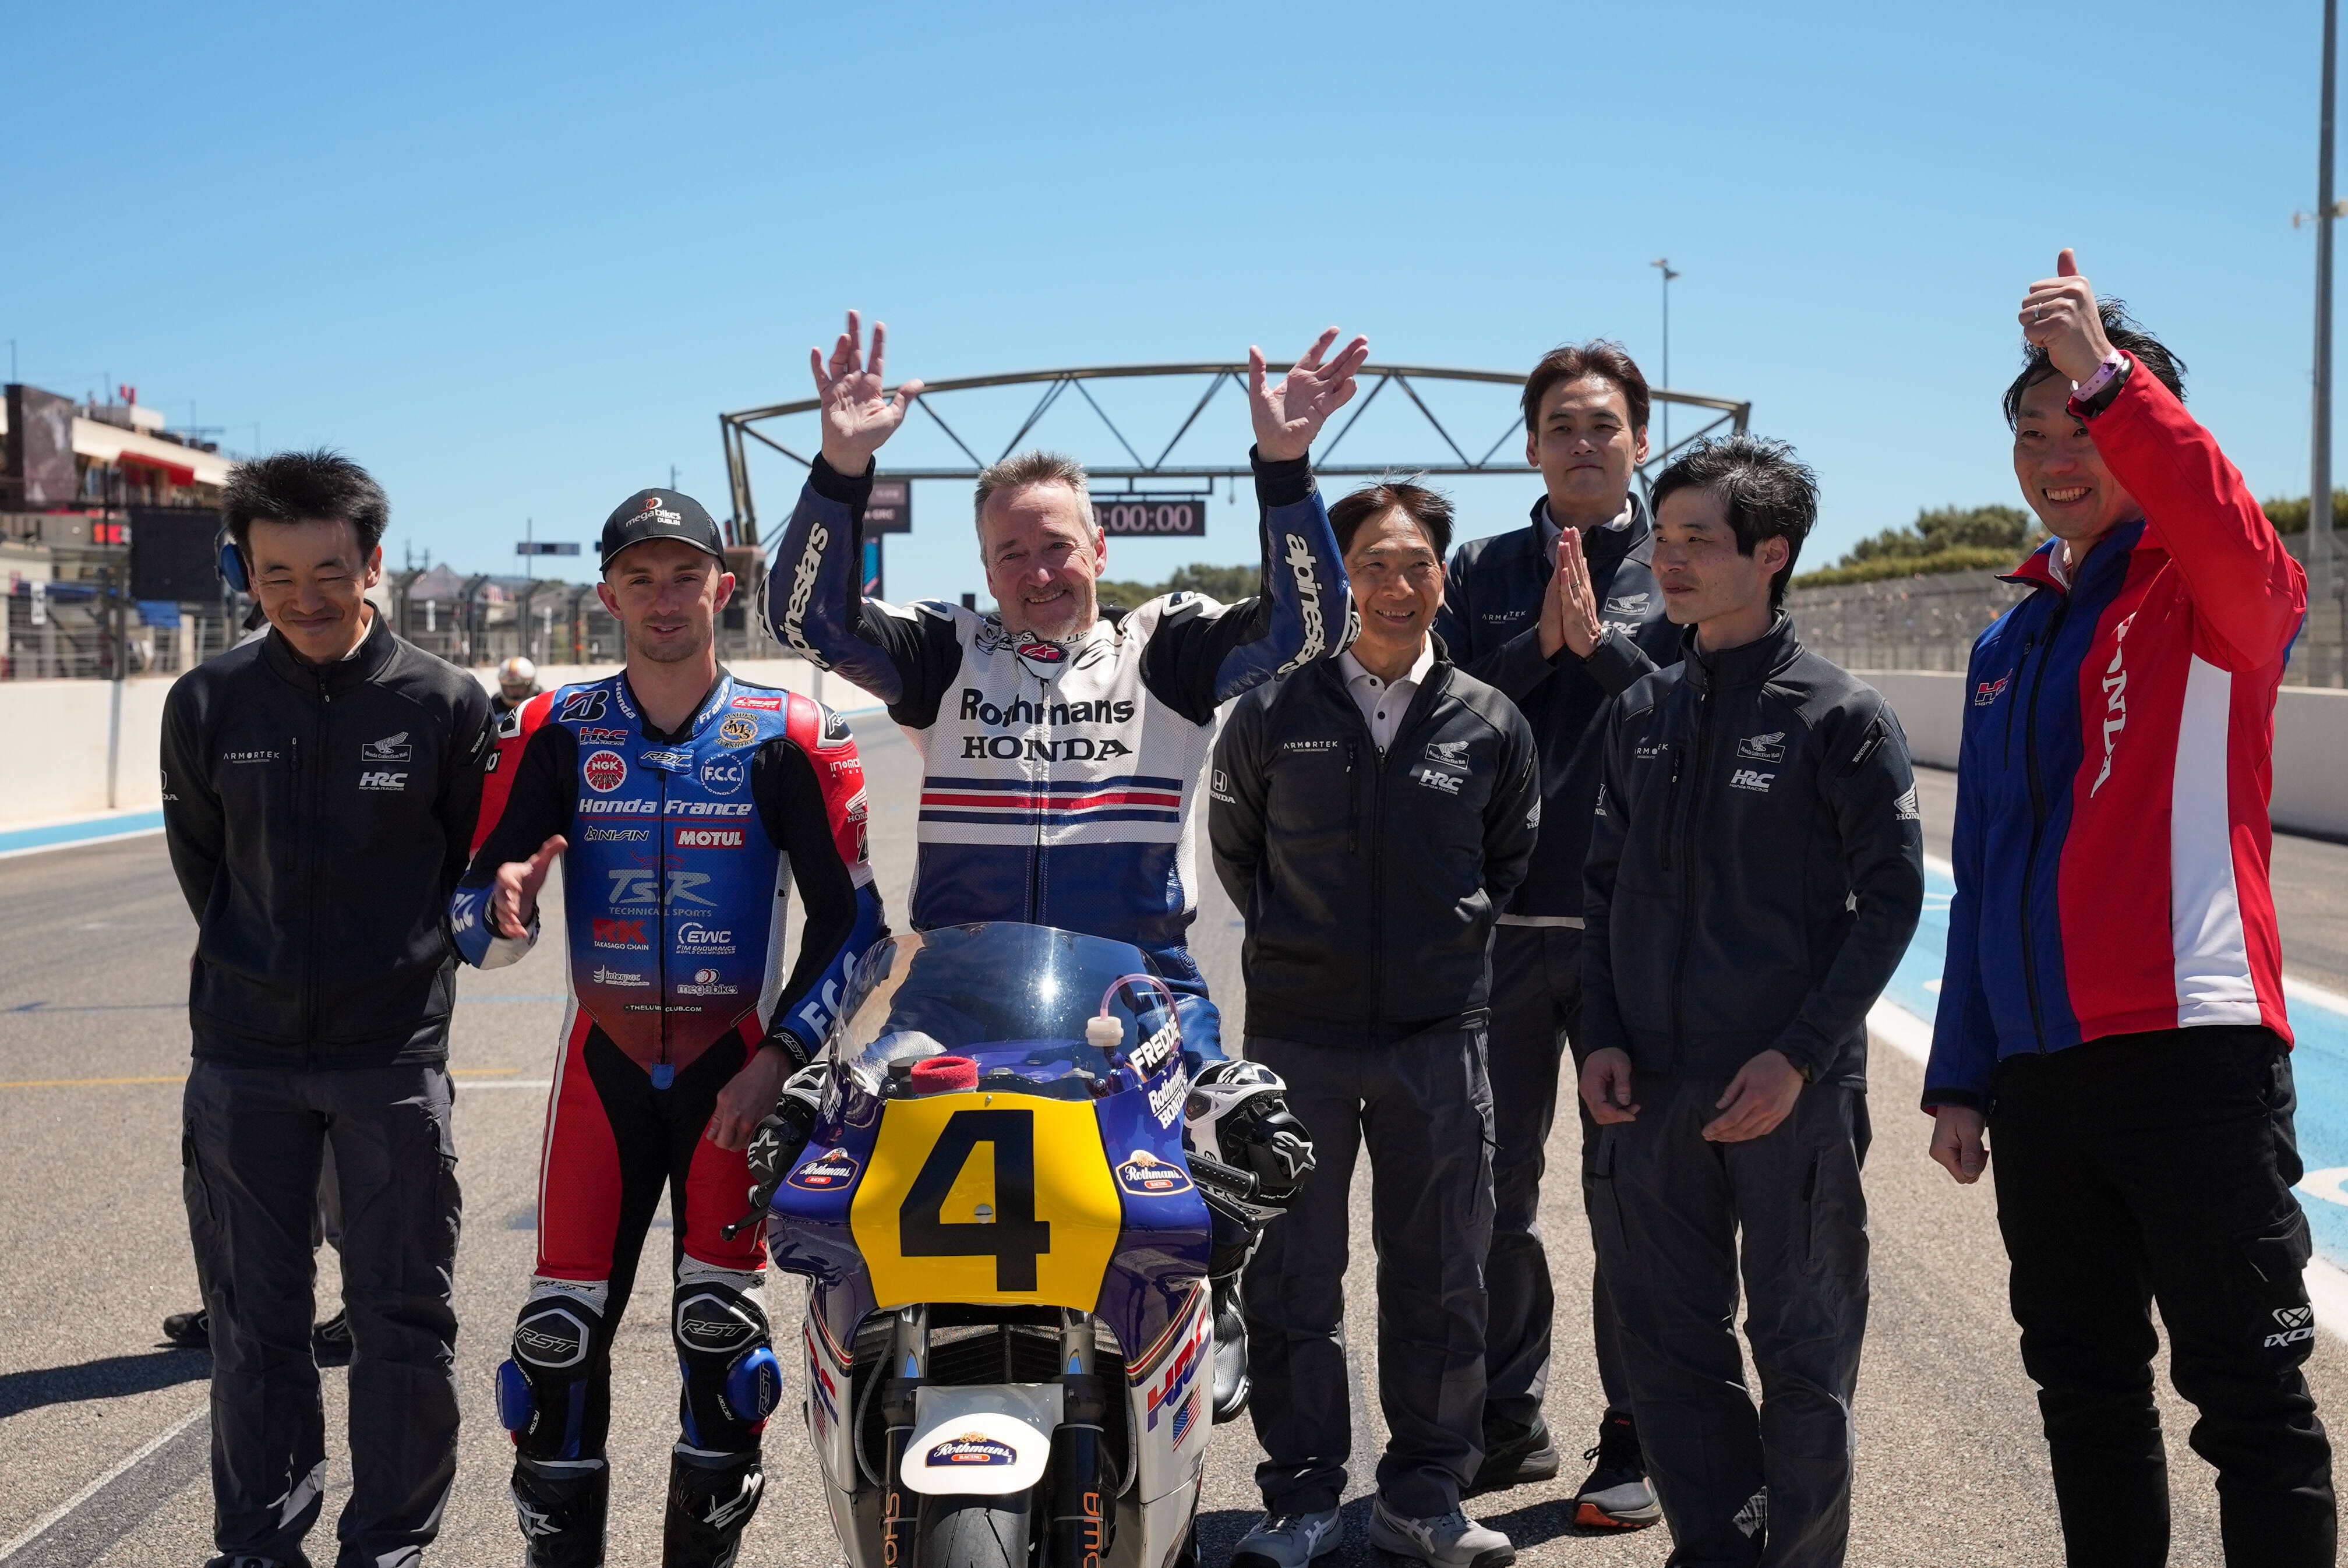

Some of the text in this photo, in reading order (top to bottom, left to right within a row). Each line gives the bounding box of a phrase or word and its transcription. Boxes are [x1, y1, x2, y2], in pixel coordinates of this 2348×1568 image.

[626, 508, 681, 528] megabikes
[657, 517, 681, 526] DUBLIN
[1482, 610, 1526, 620] ARMOTEK
[616, 681, 637, 720] Honda
[699, 681, 729, 724] France
[959, 688, 1135, 728] Rothmans
[724, 712, 760, 721] MAIDENS
[580, 727, 628, 741] HRC
[961, 736, 1133, 762] HONDA
[1283, 741, 1338, 750] ARMORTEK
[1852, 739, 1872, 763] TSDESIGN
[640, 750, 693, 764] RST
[592, 761, 618, 771] NGK
[705, 766, 741, 781] F.C.C.
[358, 771, 408, 786] HRC
[1420, 769, 1464, 792] HRC
[1731, 769, 1775, 789] HRC
[1418, 782, 1458, 795] Honda RACING
[578, 799, 753, 815] Honda France
[1594, 808, 1608, 817] NDA
[677, 831, 743, 846] MOTUL
[608, 870, 719, 907] TSR
[609, 907, 712, 917] TECHNICAL SPORTS
[593, 918, 648, 944] RK
[686, 930, 732, 943] EWC
[594, 941, 626, 950] TAKASAGO
[606, 970, 641, 982] interpac
[677, 984, 739, 997] megabikes
[772, 1032, 808, 1064] RST
[1129, 1013, 1180, 1076] FREDDIE
[1158, 1087, 1187, 1129] HONDA
[799, 1162, 851, 1178] Rothmans
[1124, 1166, 1182, 1181] Rothmans
[900, 1110, 1050, 1291] 4
[682, 1319, 750, 1337] RST
[517, 1327, 578, 1353] RST
[758, 1363, 771, 1417] RST
[934, 1442, 1013, 1458] Rothmans
[884, 1492, 900, 1568] SHO
